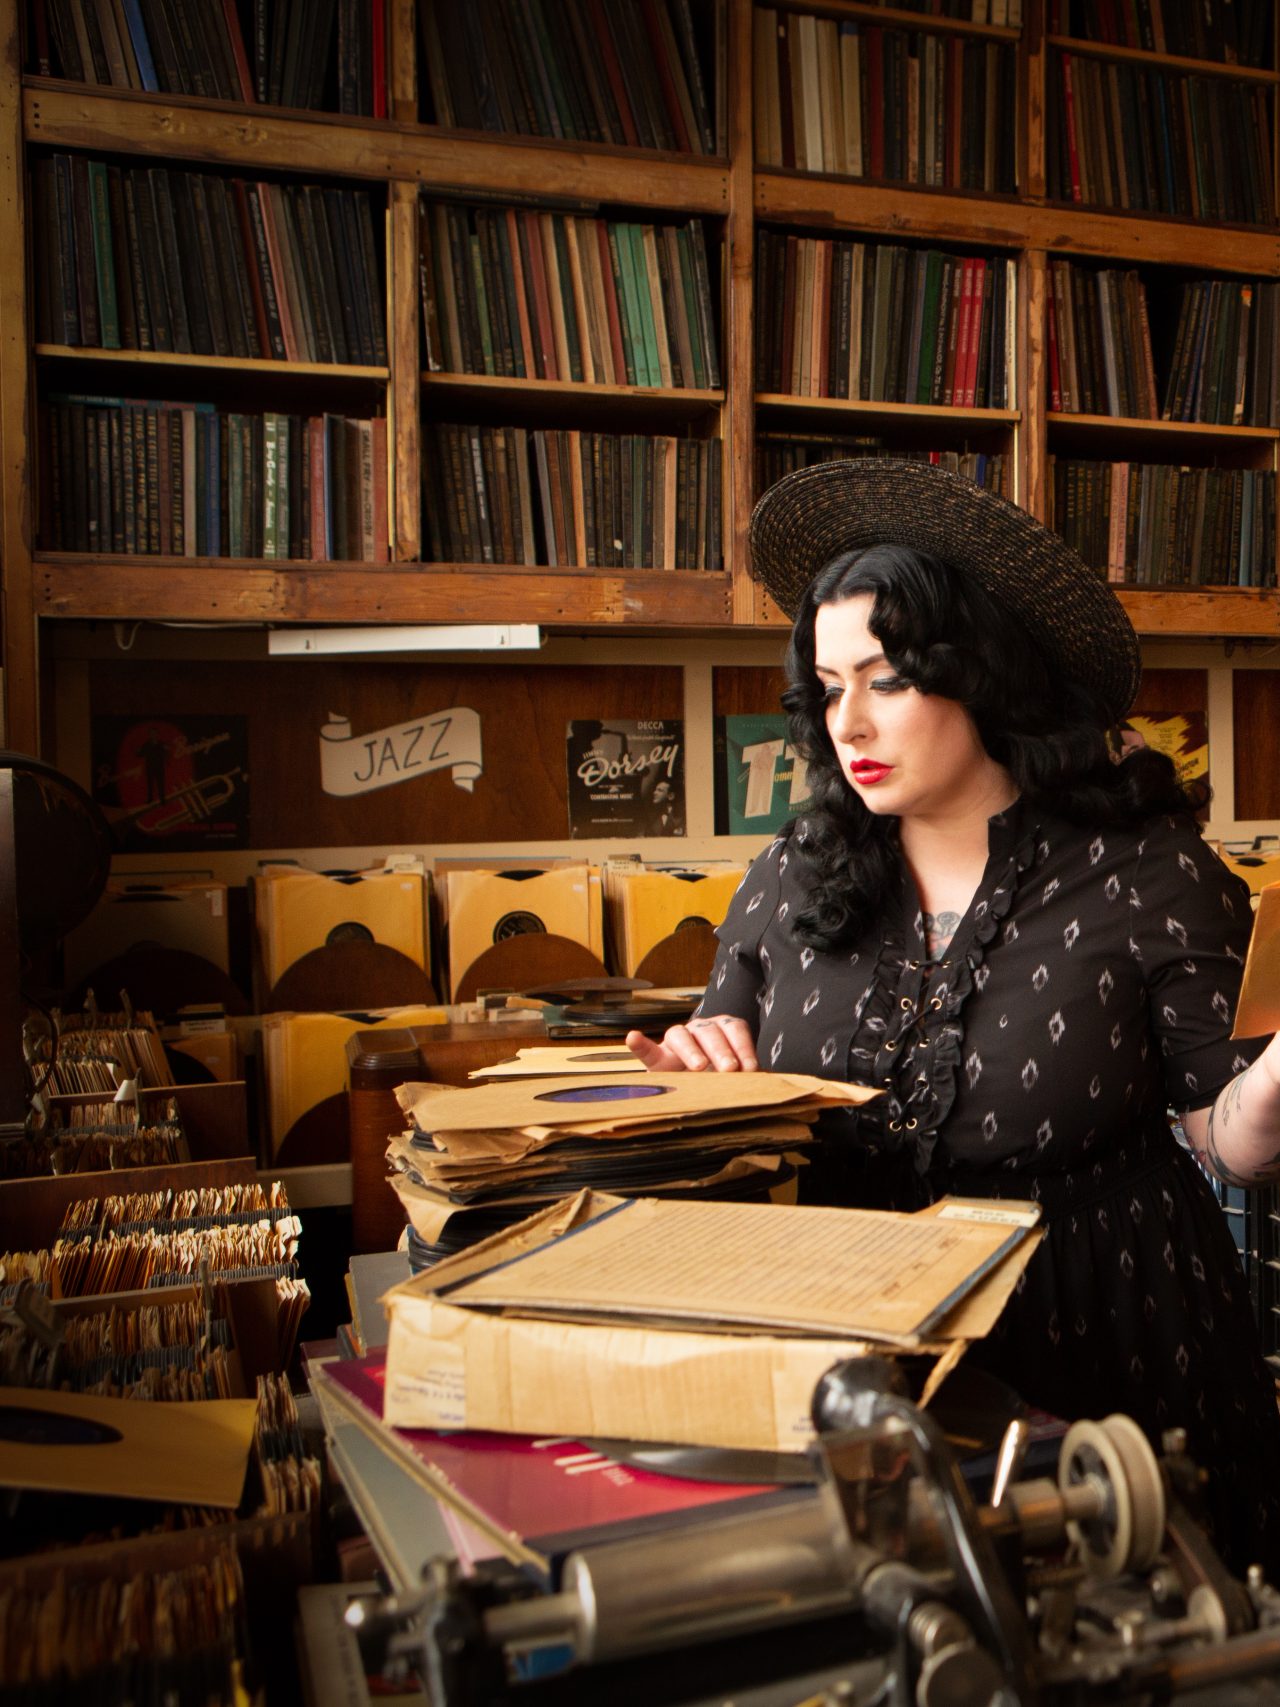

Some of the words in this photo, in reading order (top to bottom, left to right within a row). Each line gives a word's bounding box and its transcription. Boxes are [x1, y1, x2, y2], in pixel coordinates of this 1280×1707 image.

[637, 721, 664, 731] DECCA
[354, 717, 452, 782] JAZZ
[577, 744, 679, 787] Dorsey
